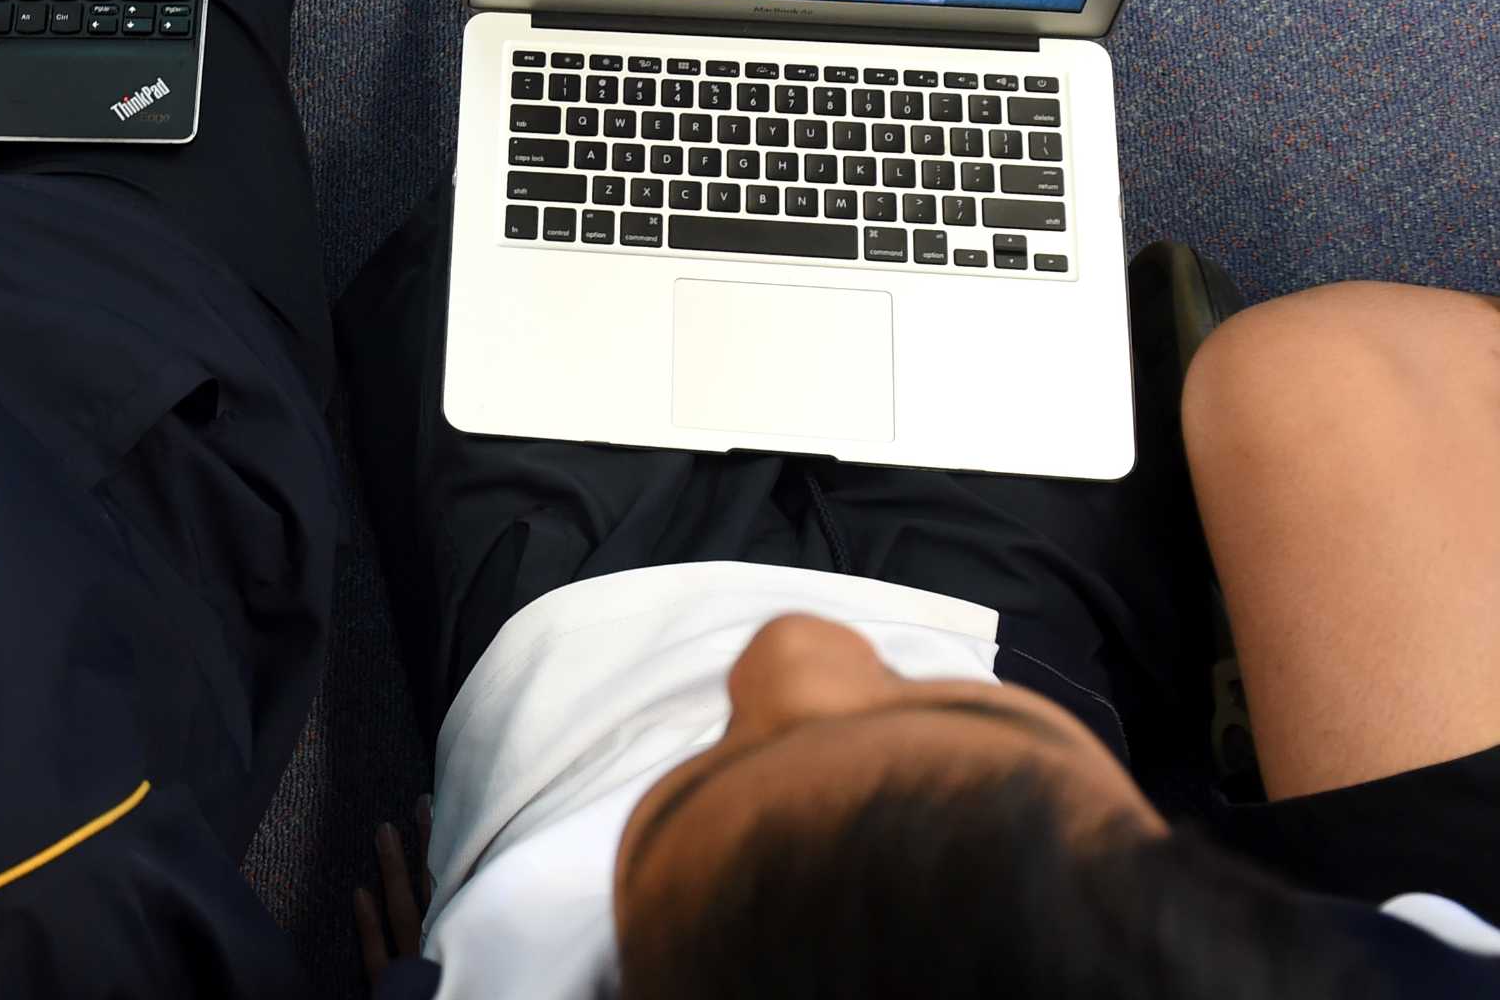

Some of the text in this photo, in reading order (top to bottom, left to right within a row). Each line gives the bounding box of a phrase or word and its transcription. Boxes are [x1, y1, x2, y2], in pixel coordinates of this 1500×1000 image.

[110, 77, 171, 121] ThinkPad
[578, 116, 587, 126] Q
[615, 118, 626, 128] W
[654, 120, 660, 130] E
[692, 122, 700, 131] R
[731, 124, 738, 133] T
[770, 126, 776, 136] Y
[806, 128, 815, 138] U
[848, 130, 852, 140] I
[884, 132, 894, 142] O
[924, 134, 932, 144] P
[587, 150, 595, 160] A
[626, 152, 632, 162] S
[663, 154, 672, 164] D
[702, 156, 708, 166] F
[739, 158, 748, 168] G
[778, 160, 787, 170] H
[819, 163, 824, 172] J
[856, 165, 864, 174] K
[896, 168, 903, 176] L
[605, 184, 612, 194] Z
[643, 187, 651, 196] X
[681, 190, 689, 200] C
[720, 192, 728, 201] V
[759, 194, 766, 204] B
[798, 196, 806, 206] N
[836, 198, 846, 208] M
[624, 234, 658, 242] command
[870, 248, 903, 258] command
